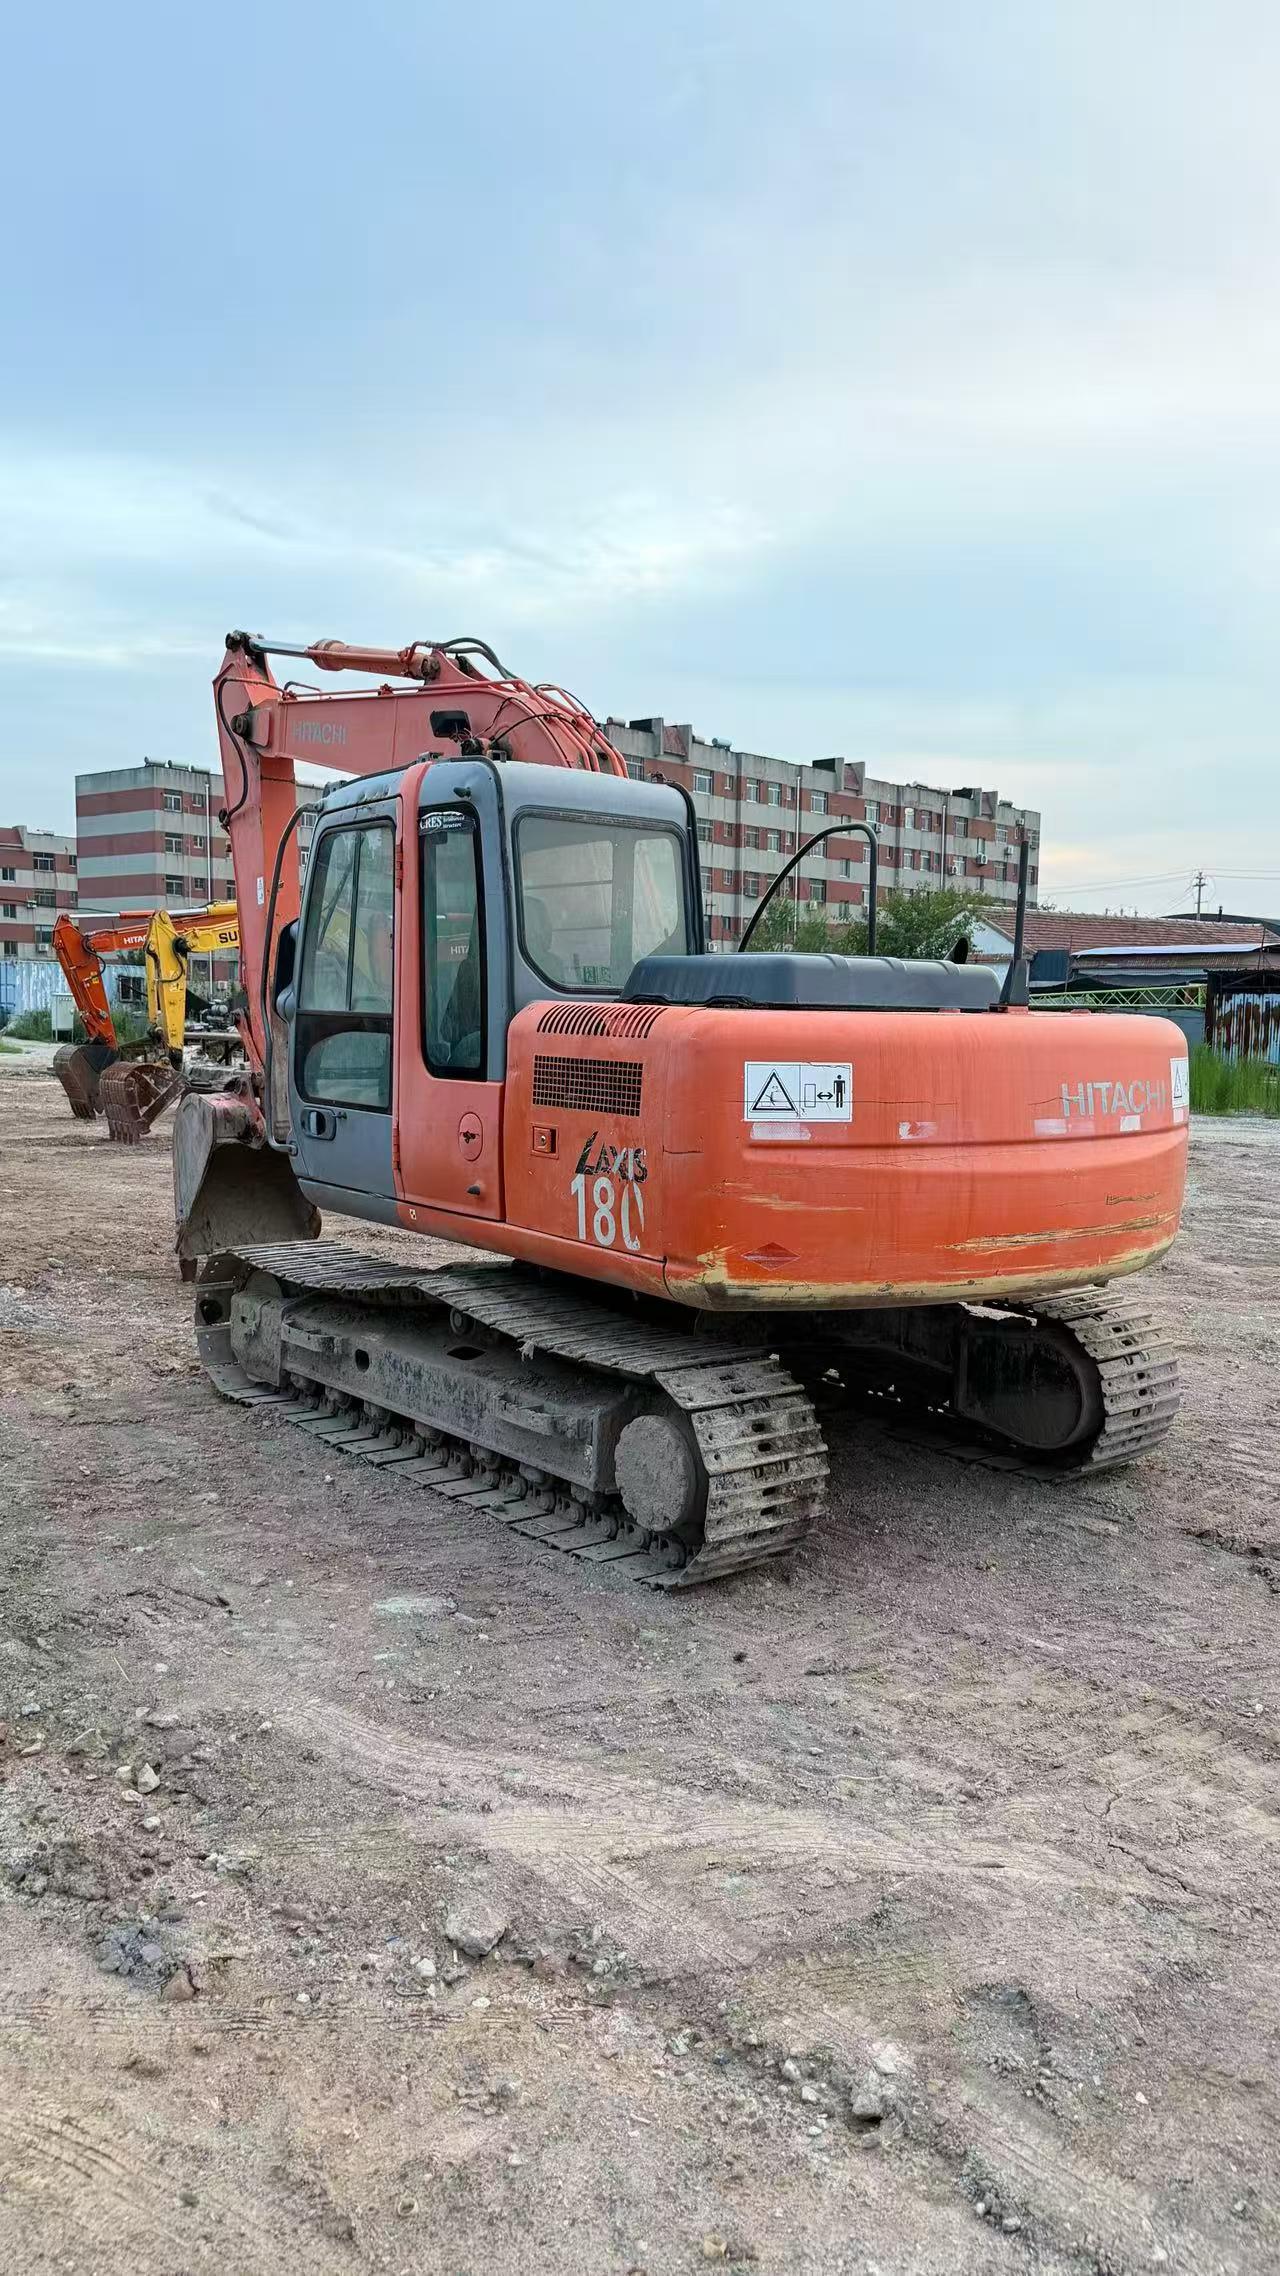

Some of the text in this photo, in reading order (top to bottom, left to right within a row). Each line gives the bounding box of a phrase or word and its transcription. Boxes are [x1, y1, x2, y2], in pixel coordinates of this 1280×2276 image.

[291, 719, 347, 745] HITACHI
[1061, 1080, 1167, 1118] HITACHI
[571, 1173, 645, 1251] 180
